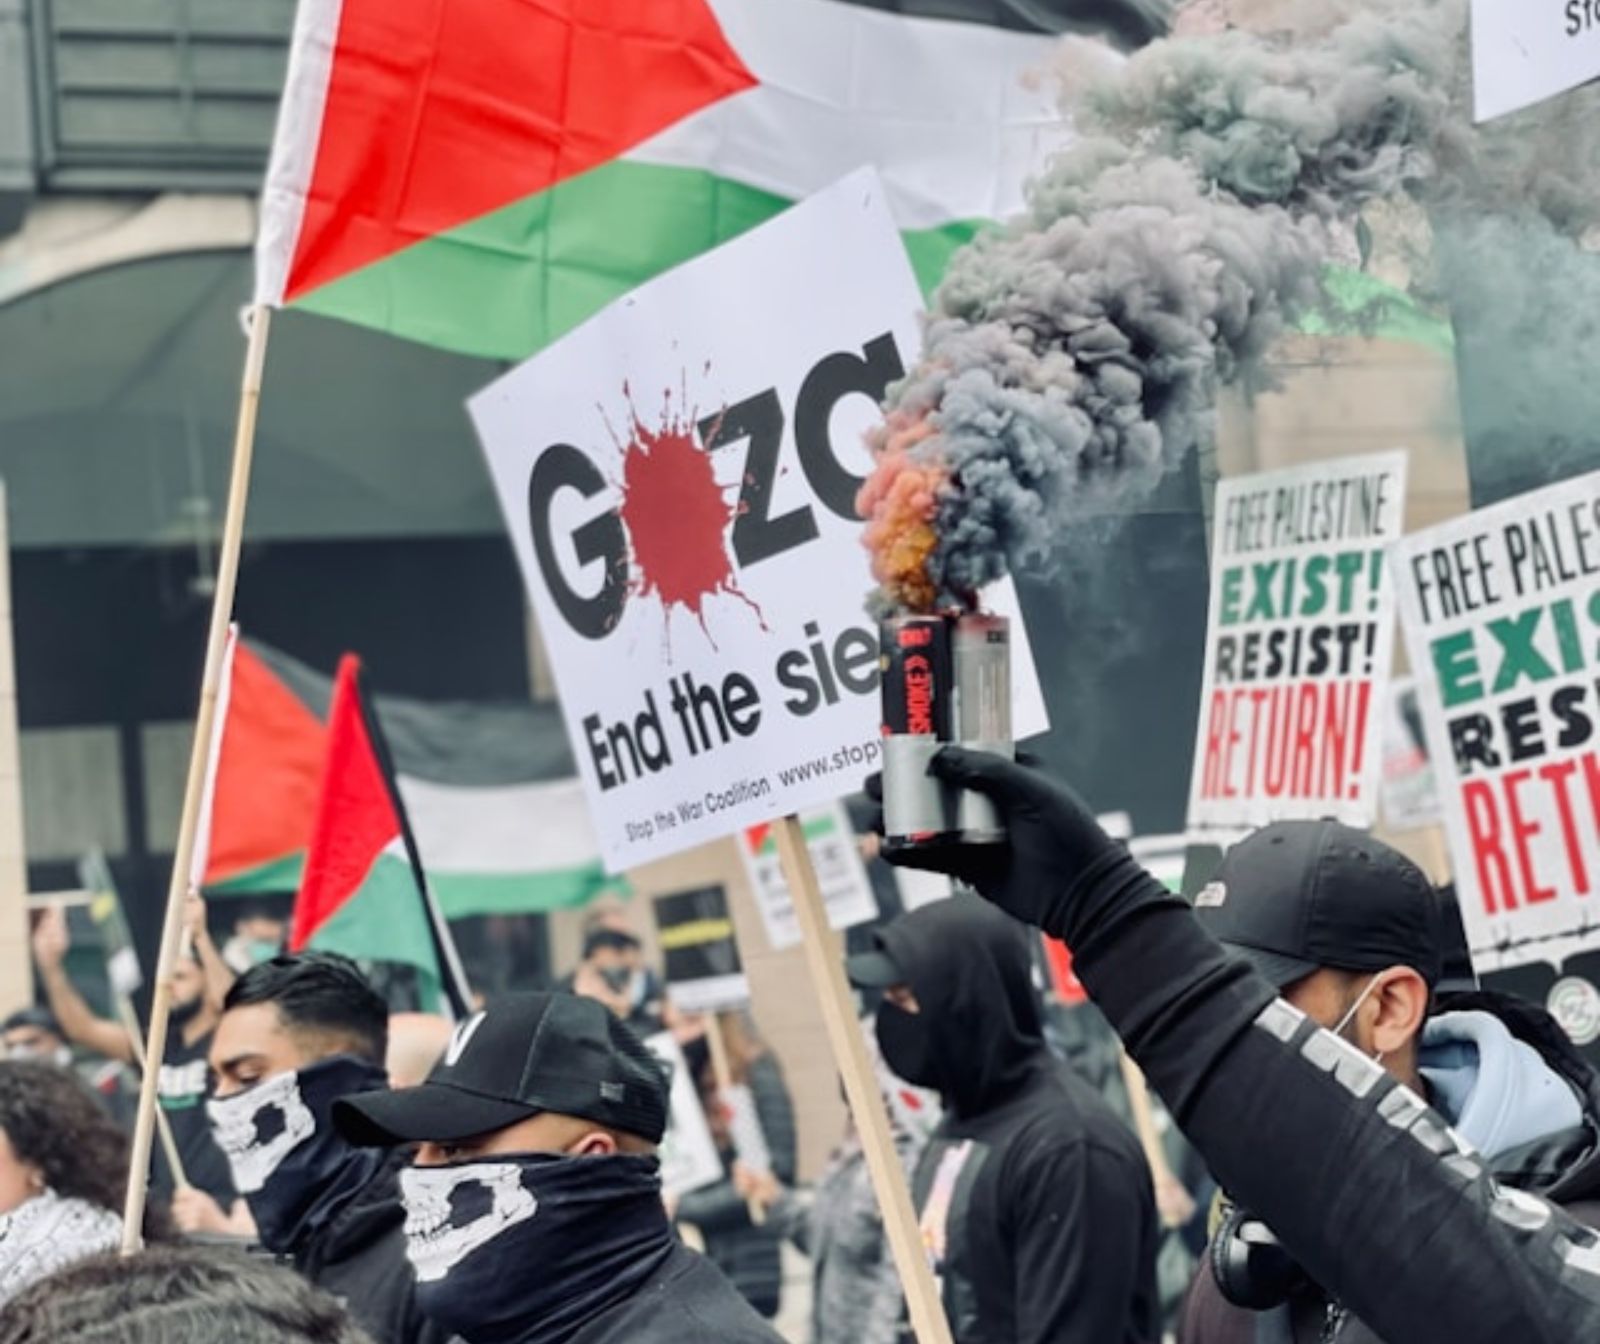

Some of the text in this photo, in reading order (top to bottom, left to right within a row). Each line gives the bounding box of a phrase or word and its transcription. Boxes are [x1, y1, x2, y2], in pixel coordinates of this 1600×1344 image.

[1222, 473, 1389, 554] FREE PALESTINE
[1219, 549, 1384, 626] EXIST!
[1410, 534, 1500, 624] FREE
[1215, 623, 1377, 682] RESIST!
[1430, 588, 1600, 709] EXI
[583, 689, 672, 792] End
[669, 671, 762, 756] the
[1201, 681, 1371, 800] RETURN!
[1447, 678, 1600, 775] RES
[625, 820, 653, 842] Stop
[654, 812, 677, 830] the
[677, 800, 702, 823] War
[703, 775, 771, 814] Coalition
